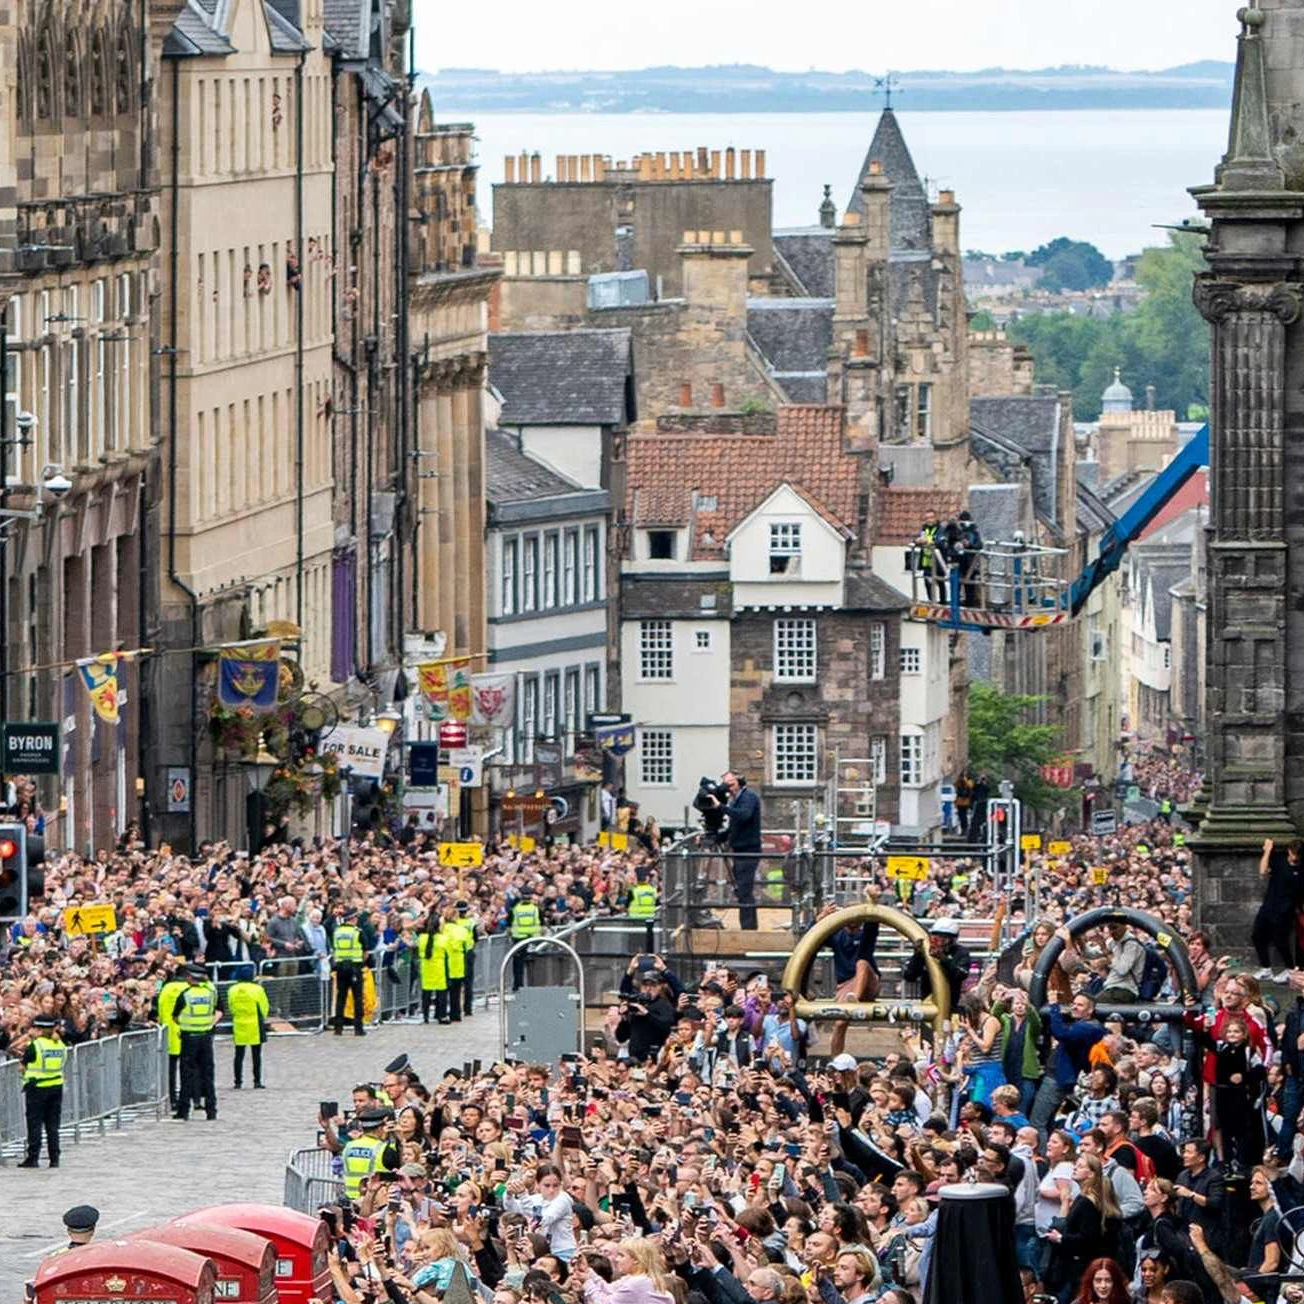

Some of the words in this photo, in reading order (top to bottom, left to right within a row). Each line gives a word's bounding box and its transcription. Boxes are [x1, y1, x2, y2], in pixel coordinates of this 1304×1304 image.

[8, 735, 53, 751] BYRON
[323, 741, 344, 755] FOR
[348, 745, 380, 759] SALE
